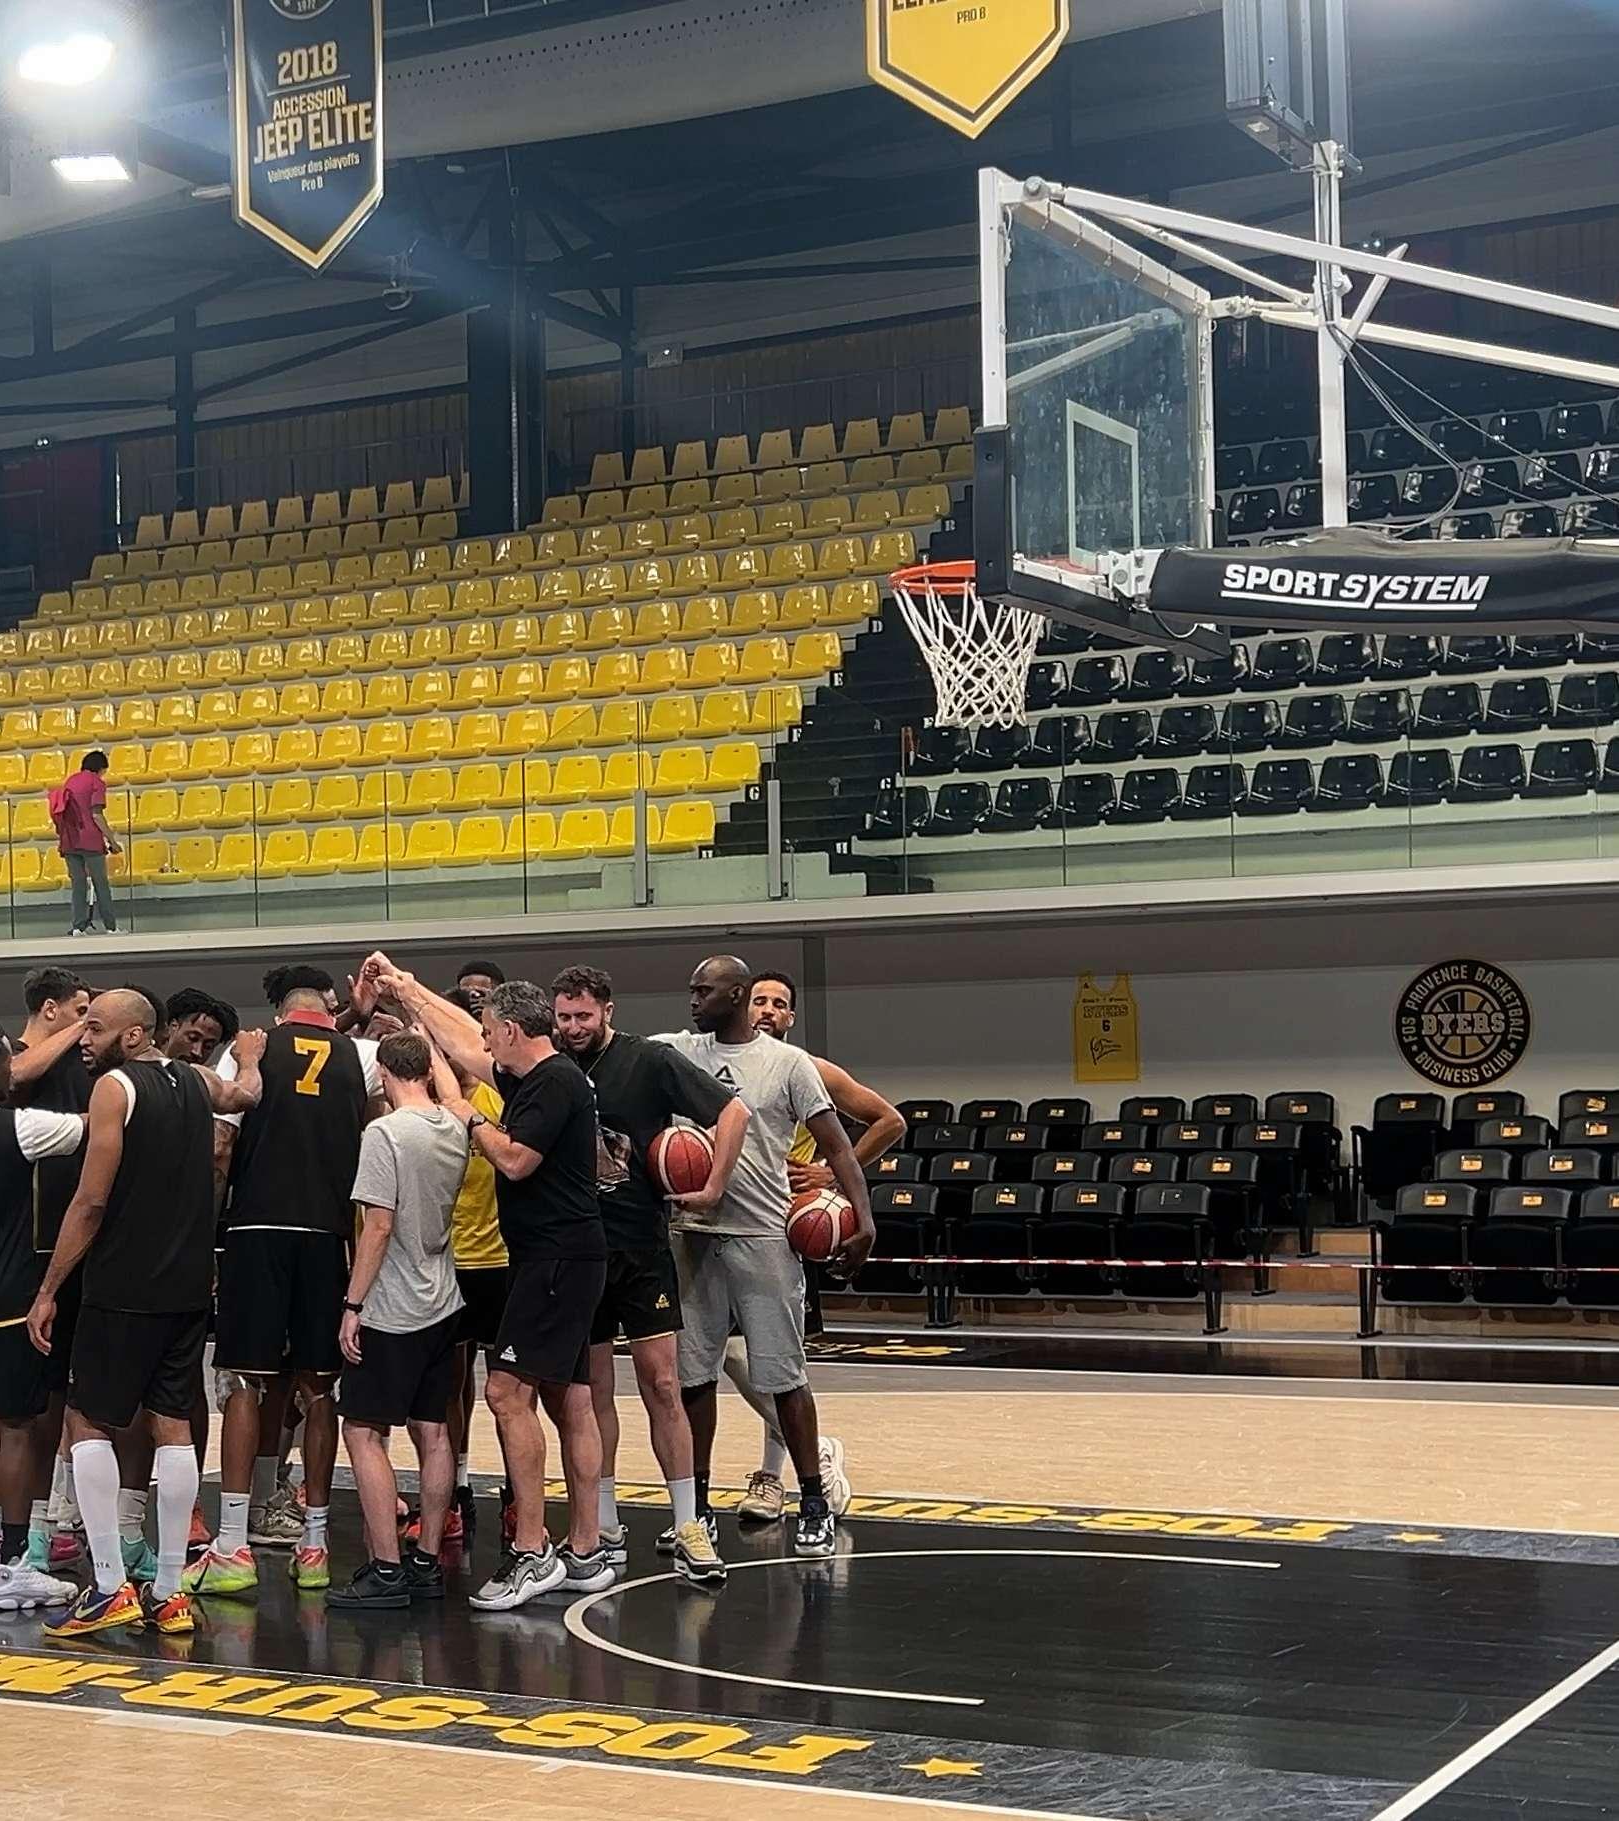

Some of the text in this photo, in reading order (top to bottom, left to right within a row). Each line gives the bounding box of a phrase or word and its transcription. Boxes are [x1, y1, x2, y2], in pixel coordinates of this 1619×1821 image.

[956, 6, 987, 25] PRO B
[277, 40, 338, 86] 2018
[272, 85, 348, 121] ACCESSION
[253, 101, 375, 165] JEEP ELITE
[307, 160, 323, 174] des
[323, 152, 361, 173] playoffs
[301, 179, 317, 192] Pro
[833, 672, 844, 688] E
[791, 727, 802, 742] F
[748, 785, 761, 801] G
[1402, 964, 1525, 1043] FOS PROVENCE BASKETBALL
[1421, 1011, 1506, 1036] BYERS
[293, 1036, 331, 1097] 7
[1414, 1048, 1515, 1083] BUSINESS CLUB
